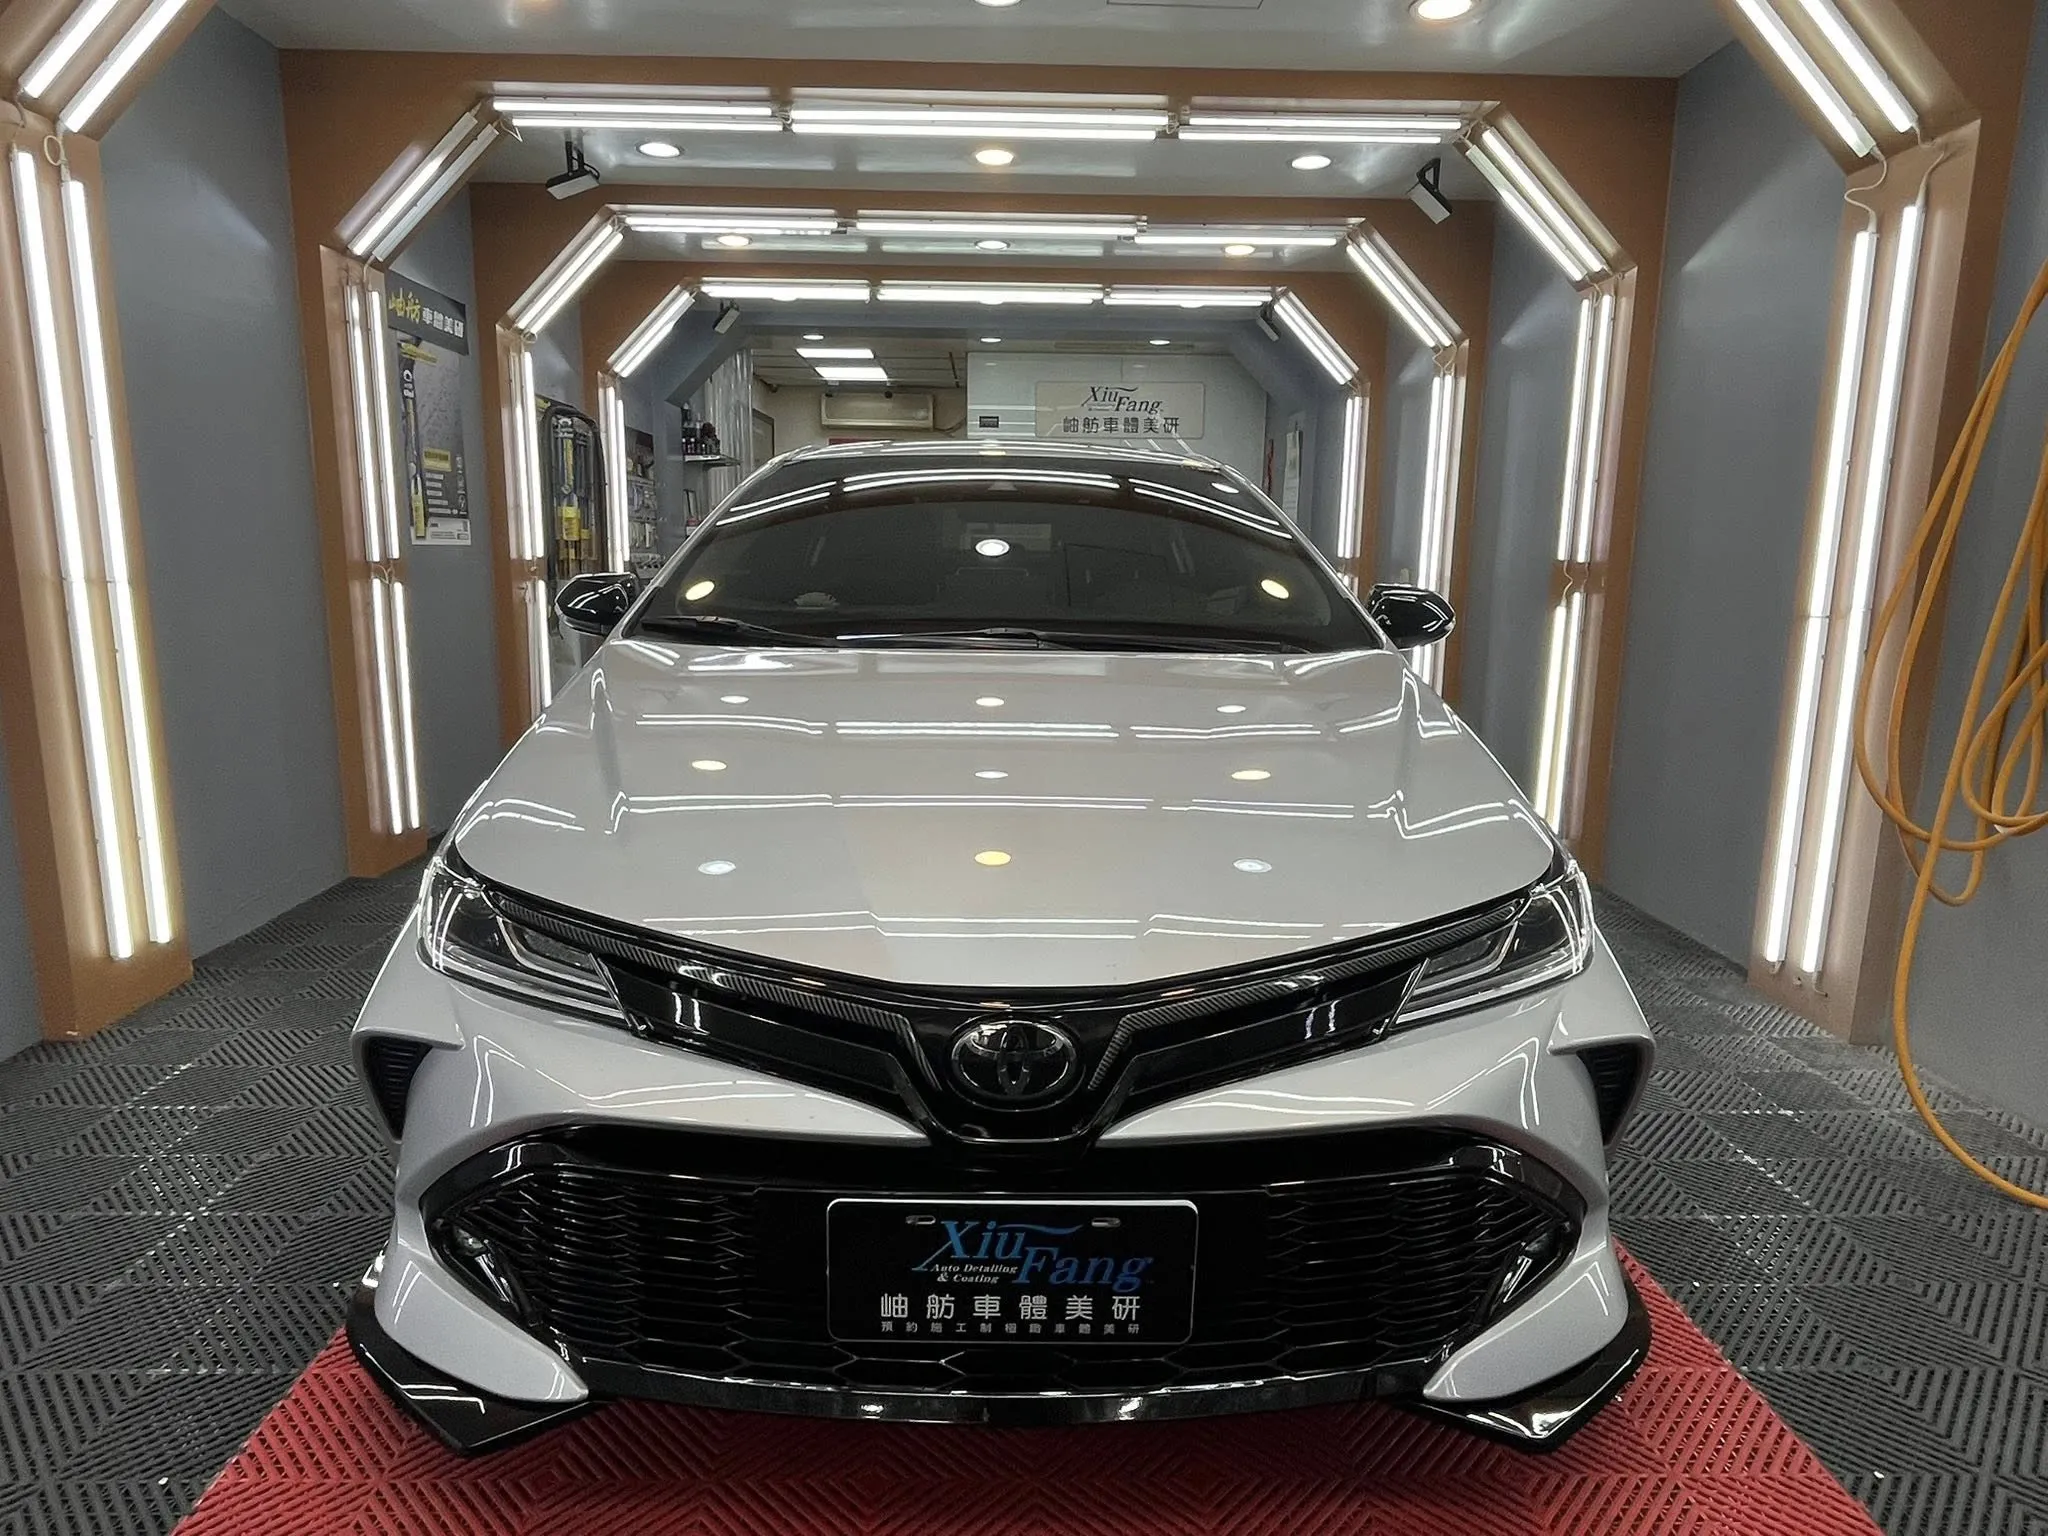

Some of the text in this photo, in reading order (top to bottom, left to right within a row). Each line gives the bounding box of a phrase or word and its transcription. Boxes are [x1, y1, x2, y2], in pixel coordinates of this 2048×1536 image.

[1081, 386, 1119, 407] Xiu
[1114, 396, 1164, 414] Fang
[1063, 416, 1180, 434] 岫舫車體美研
[911, 1220, 1155, 1293] Xiu Fang
[931, 1263, 1019, 1274] Auto Detailing
[936, 1272, 1000, 1284] & Coating
[880, 1293, 1141, 1321] 岫舫車體美研
